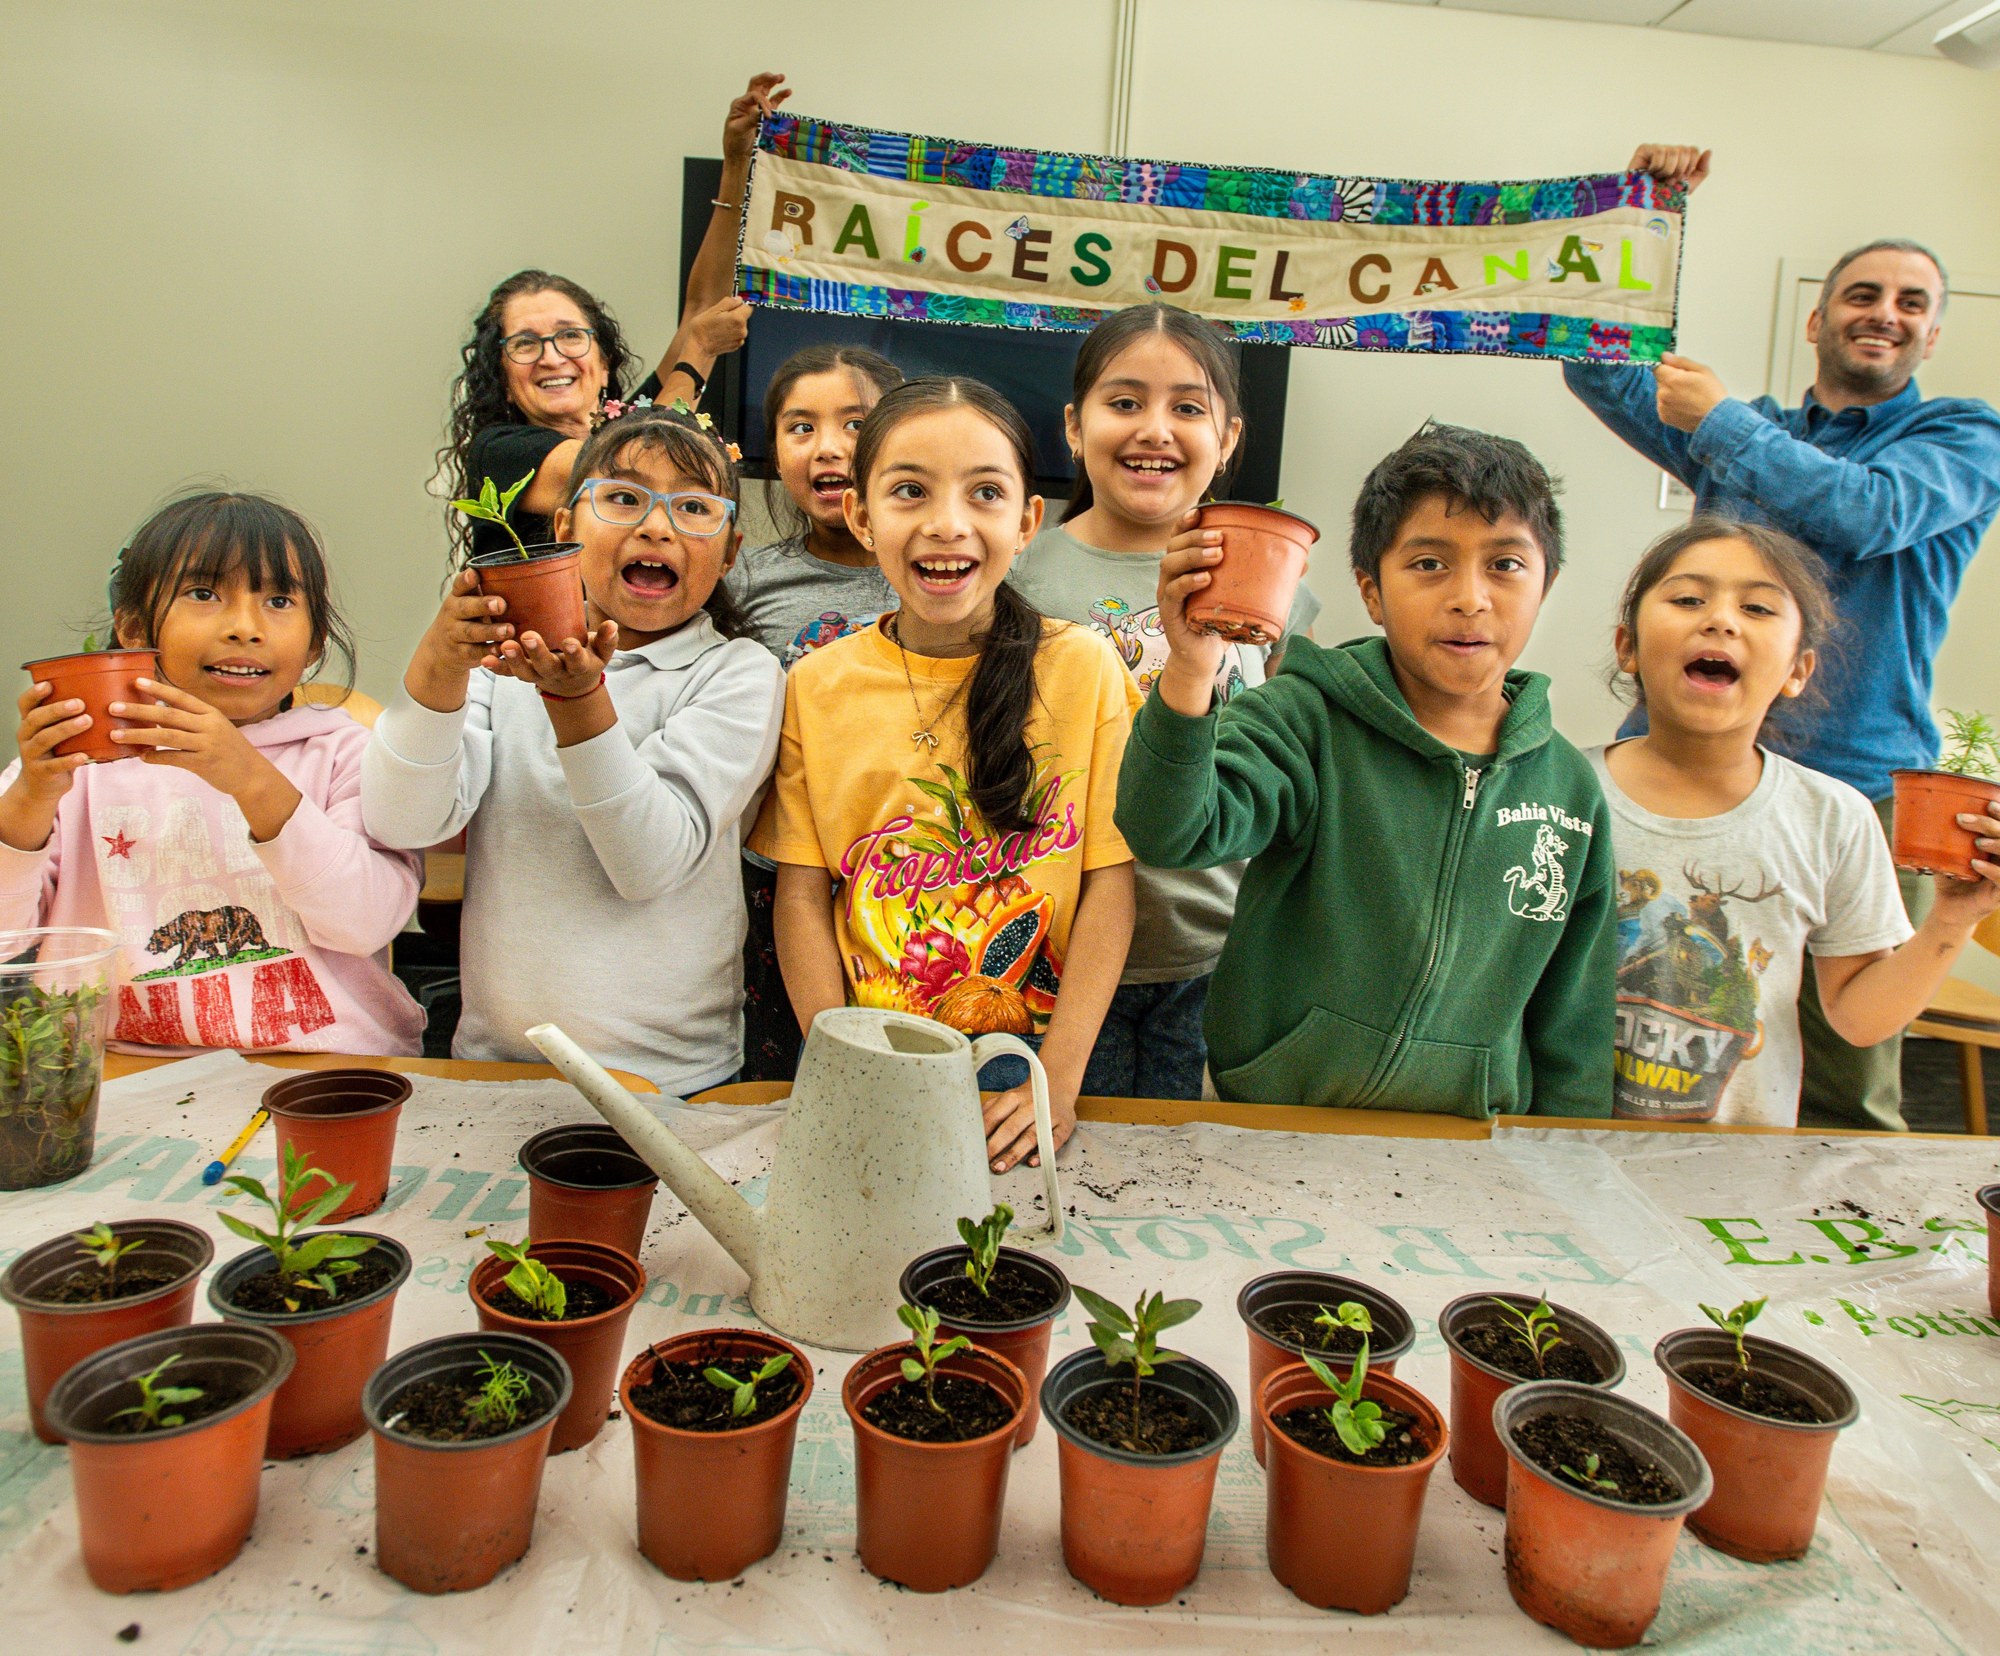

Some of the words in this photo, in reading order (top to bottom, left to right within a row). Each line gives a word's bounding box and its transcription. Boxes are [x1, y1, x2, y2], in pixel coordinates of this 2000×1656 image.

[771, 190, 1113, 287] RAÍCES
[1151, 238, 1304, 302] DEL
[1348, 234, 1653, 304] CANAL
[840, 776, 1084, 922] Tropicales
[1496, 802, 1548, 827] Bahia
[1548, 804, 1593, 837] Vista
[115, 956, 337, 1049] NIA
[1614, 1008, 1734, 1074] OCKY
[1614, 1050, 1703, 1094] ILWAY
